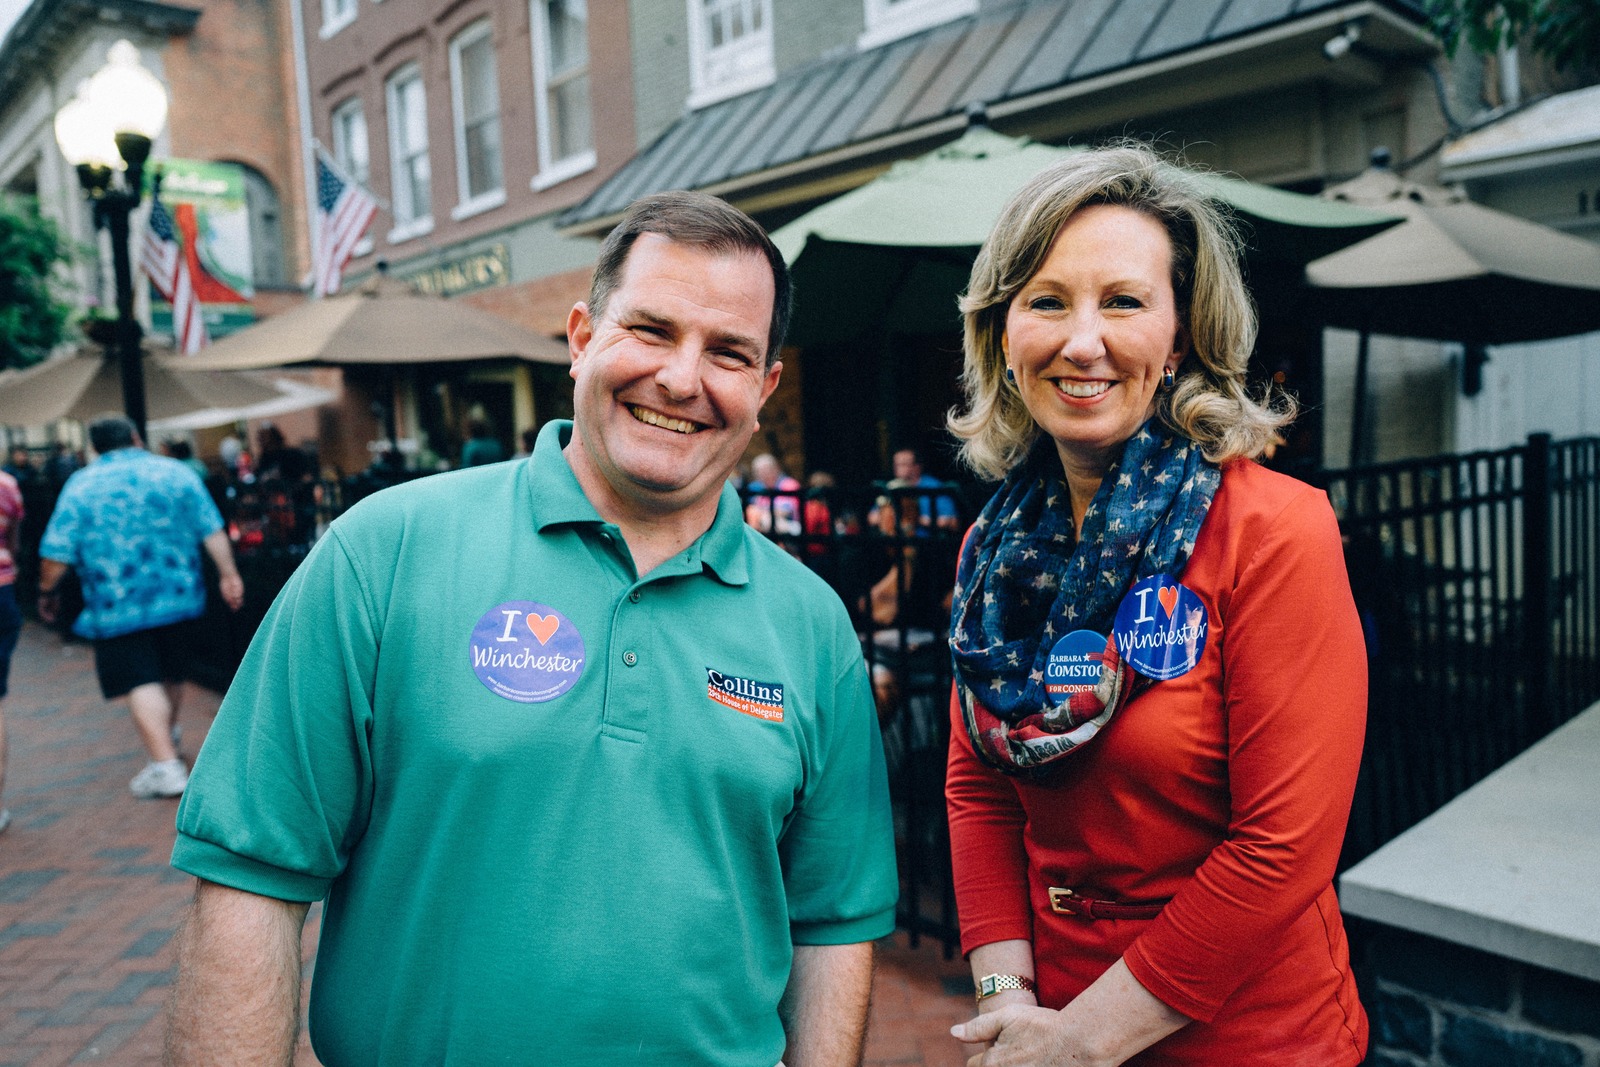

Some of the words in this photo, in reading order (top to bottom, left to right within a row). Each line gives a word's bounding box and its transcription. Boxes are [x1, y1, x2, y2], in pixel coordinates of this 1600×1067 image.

[1133, 587, 1155, 624] I
[496, 610, 522, 642] I
[1117, 622, 1207, 652] Winchester
[473, 645, 582, 673] Winchester
[1047, 662, 1103, 678] COMSTOC
[1050, 654, 1082, 663] BARBARA
[708, 669, 782, 702] Collins
[1049, 685, 1062, 693] FOR
[1062, 684, 1096, 693] CONGR
[722, 695, 741, 709] House
[741, 703, 749, 712] of
[750, 704, 783, 719] Delegates
